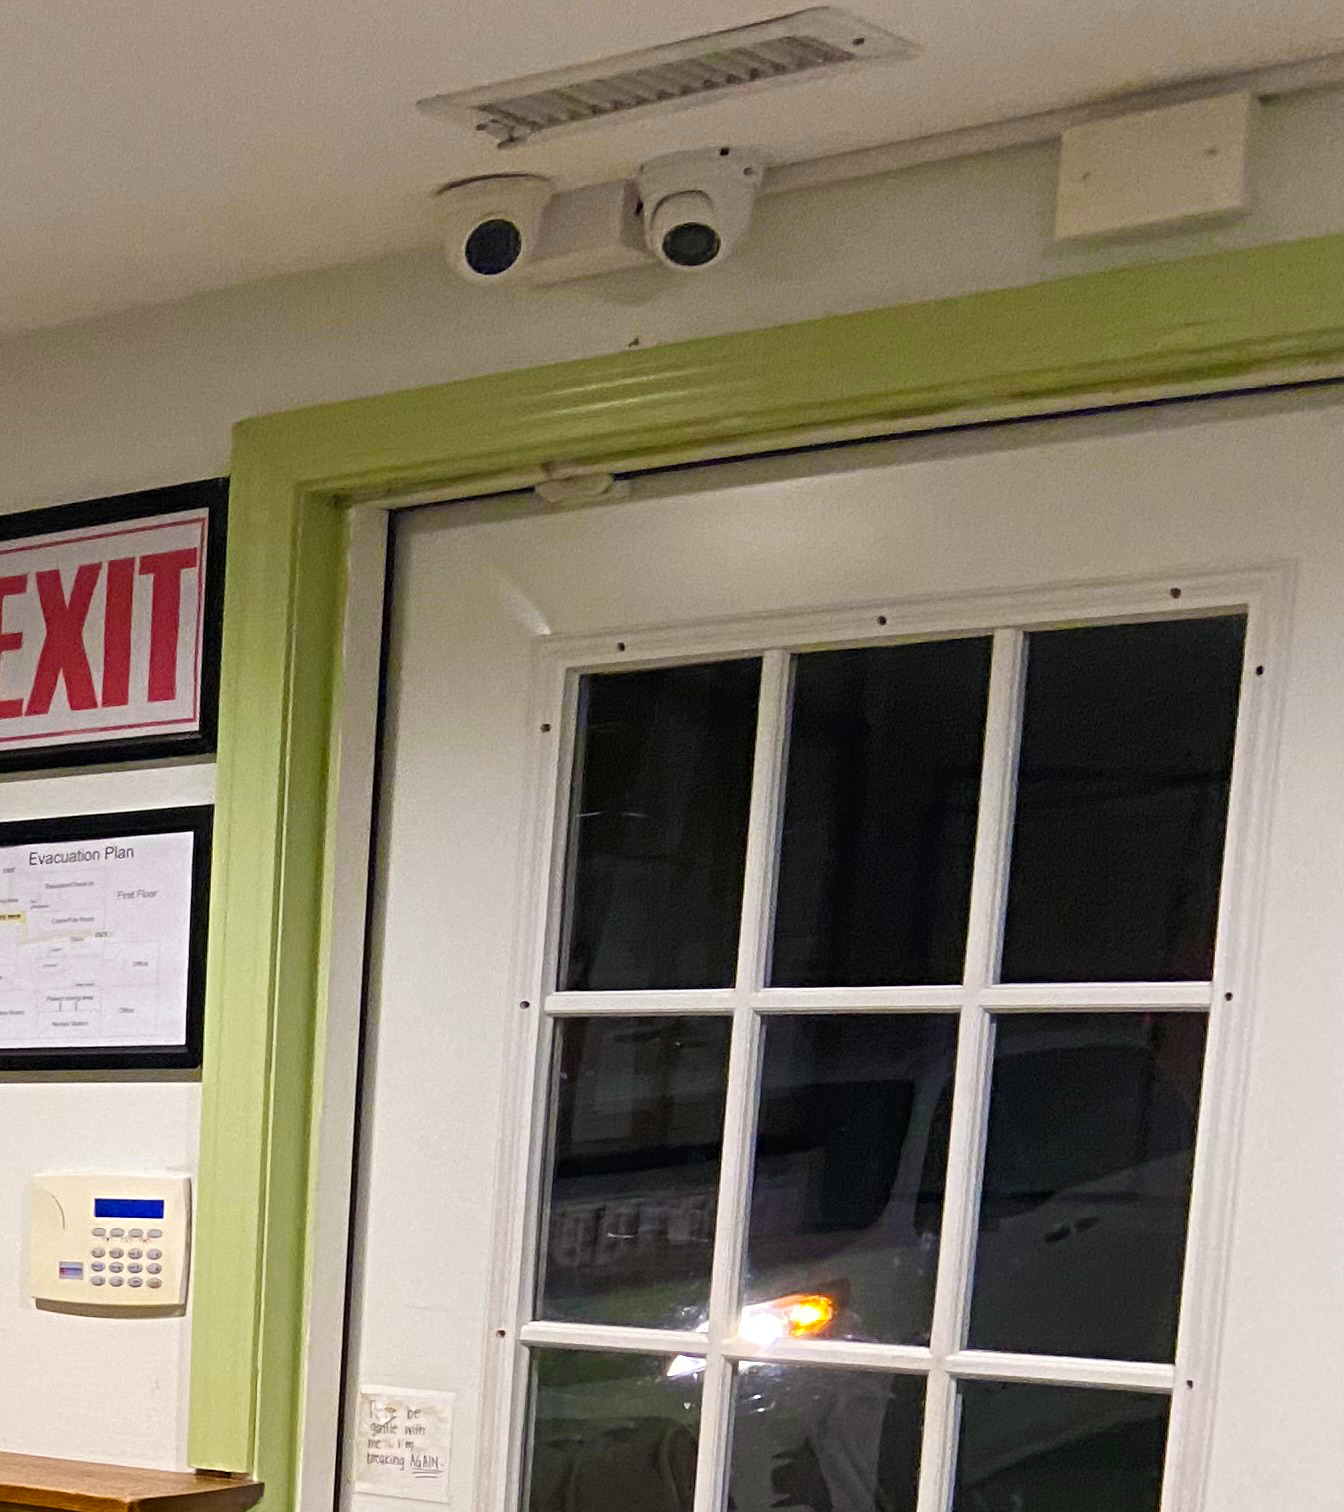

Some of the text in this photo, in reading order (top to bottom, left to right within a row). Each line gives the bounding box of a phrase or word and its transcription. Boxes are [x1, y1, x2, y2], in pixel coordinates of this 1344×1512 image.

[29, 846, 134, 866] Evacuation Plan
[117, 889, 157, 899] First Floor
[404, 1424, 426, 1435] with
[367, 1452, 404, 1471] breaking
